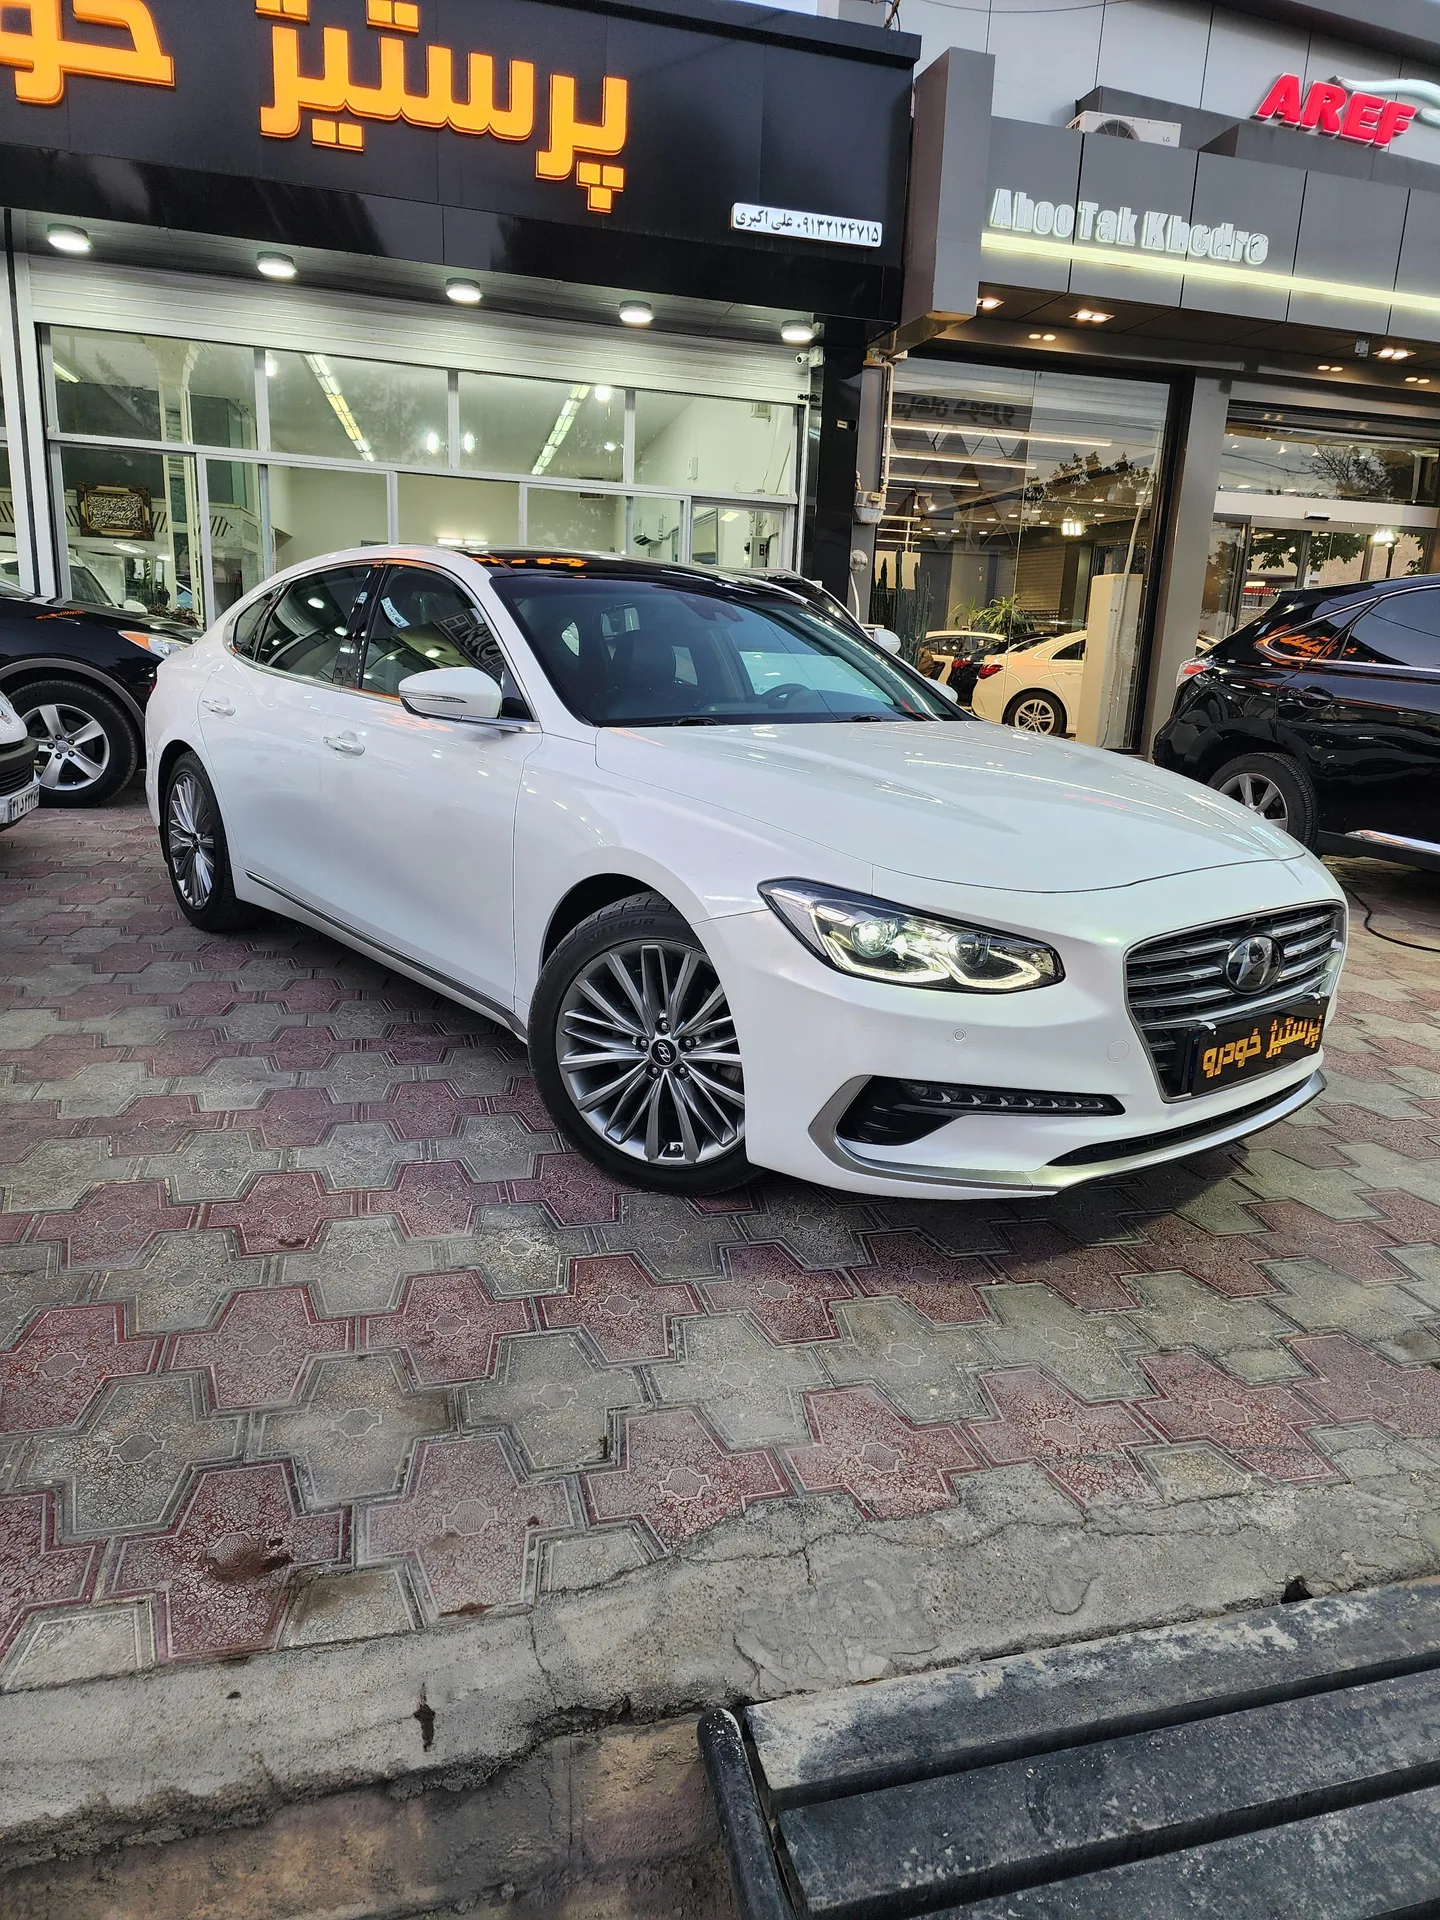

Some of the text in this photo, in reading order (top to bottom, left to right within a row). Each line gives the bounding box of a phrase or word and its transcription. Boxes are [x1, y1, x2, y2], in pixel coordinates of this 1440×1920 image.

[1252, 73, 1416, 148] AREF
[735, 210, 880, 243] ۰۹۱۳۲۱۲۴۷۱۵ علی اکبری
[1204, 1028, 1262, 1079] خودرو
